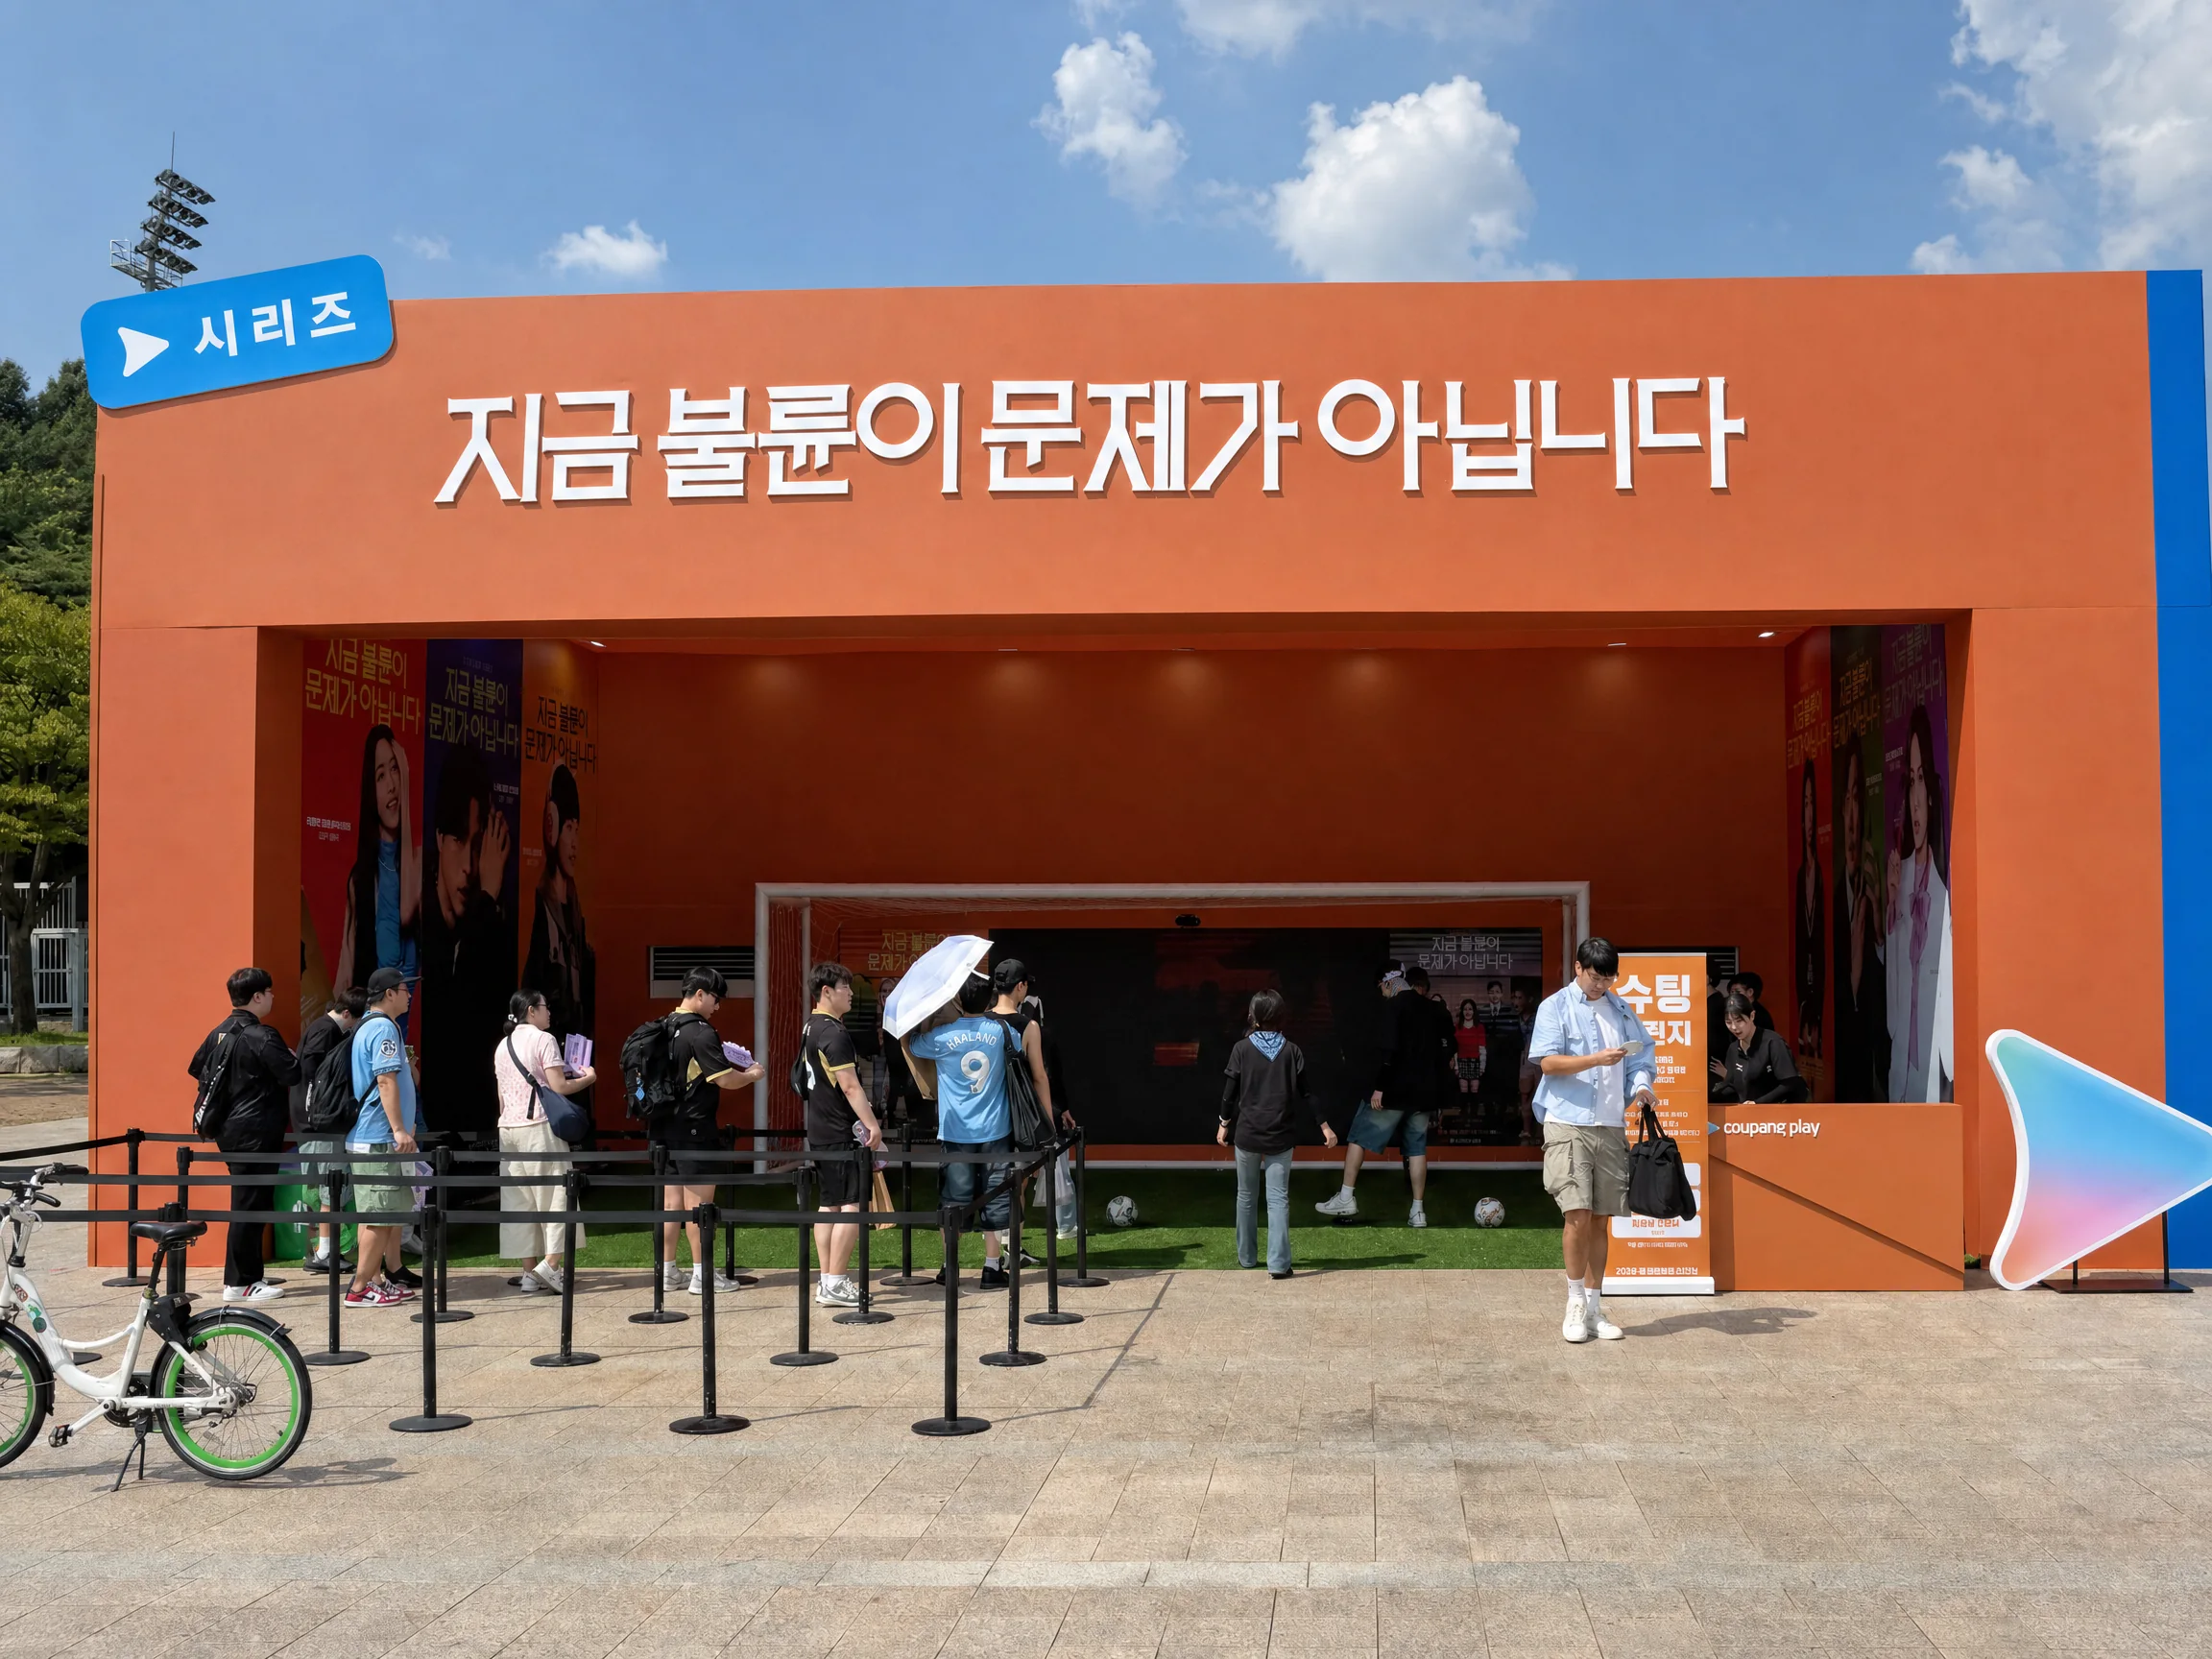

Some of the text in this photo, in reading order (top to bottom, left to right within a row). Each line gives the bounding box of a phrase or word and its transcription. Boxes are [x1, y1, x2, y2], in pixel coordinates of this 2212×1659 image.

[194, 291, 356, 357] 시리즈
[434, 376, 1746, 503] 지금 불륜이 문제가 아닙니다
[362, 639, 407, 689] 불륜이
[305, 667, 421, 734] 문제가 아닙니다
[445, 666, 508, 717] 지금 불륜이
[429, 702, 518, 758] 문제가 아닙니다
[538, 696, 557, 729] 지금
[525, 728, 597, 774] 문제가 아닙니다
[881, 932, 908, 951] 지금
[1431, 936, 1456, 951] 지금
[867, 953, 908, 972] 문제가
[1417, 953, 1513, 970] 문제가 아닙니다
[946, 1032, 997, 1050] HAALAND
[1642, 1021, 1691, 1046] 린지
[961, 1050, 990, 1094] 9
[1723, 1118, 1820, 1138] coupang play
